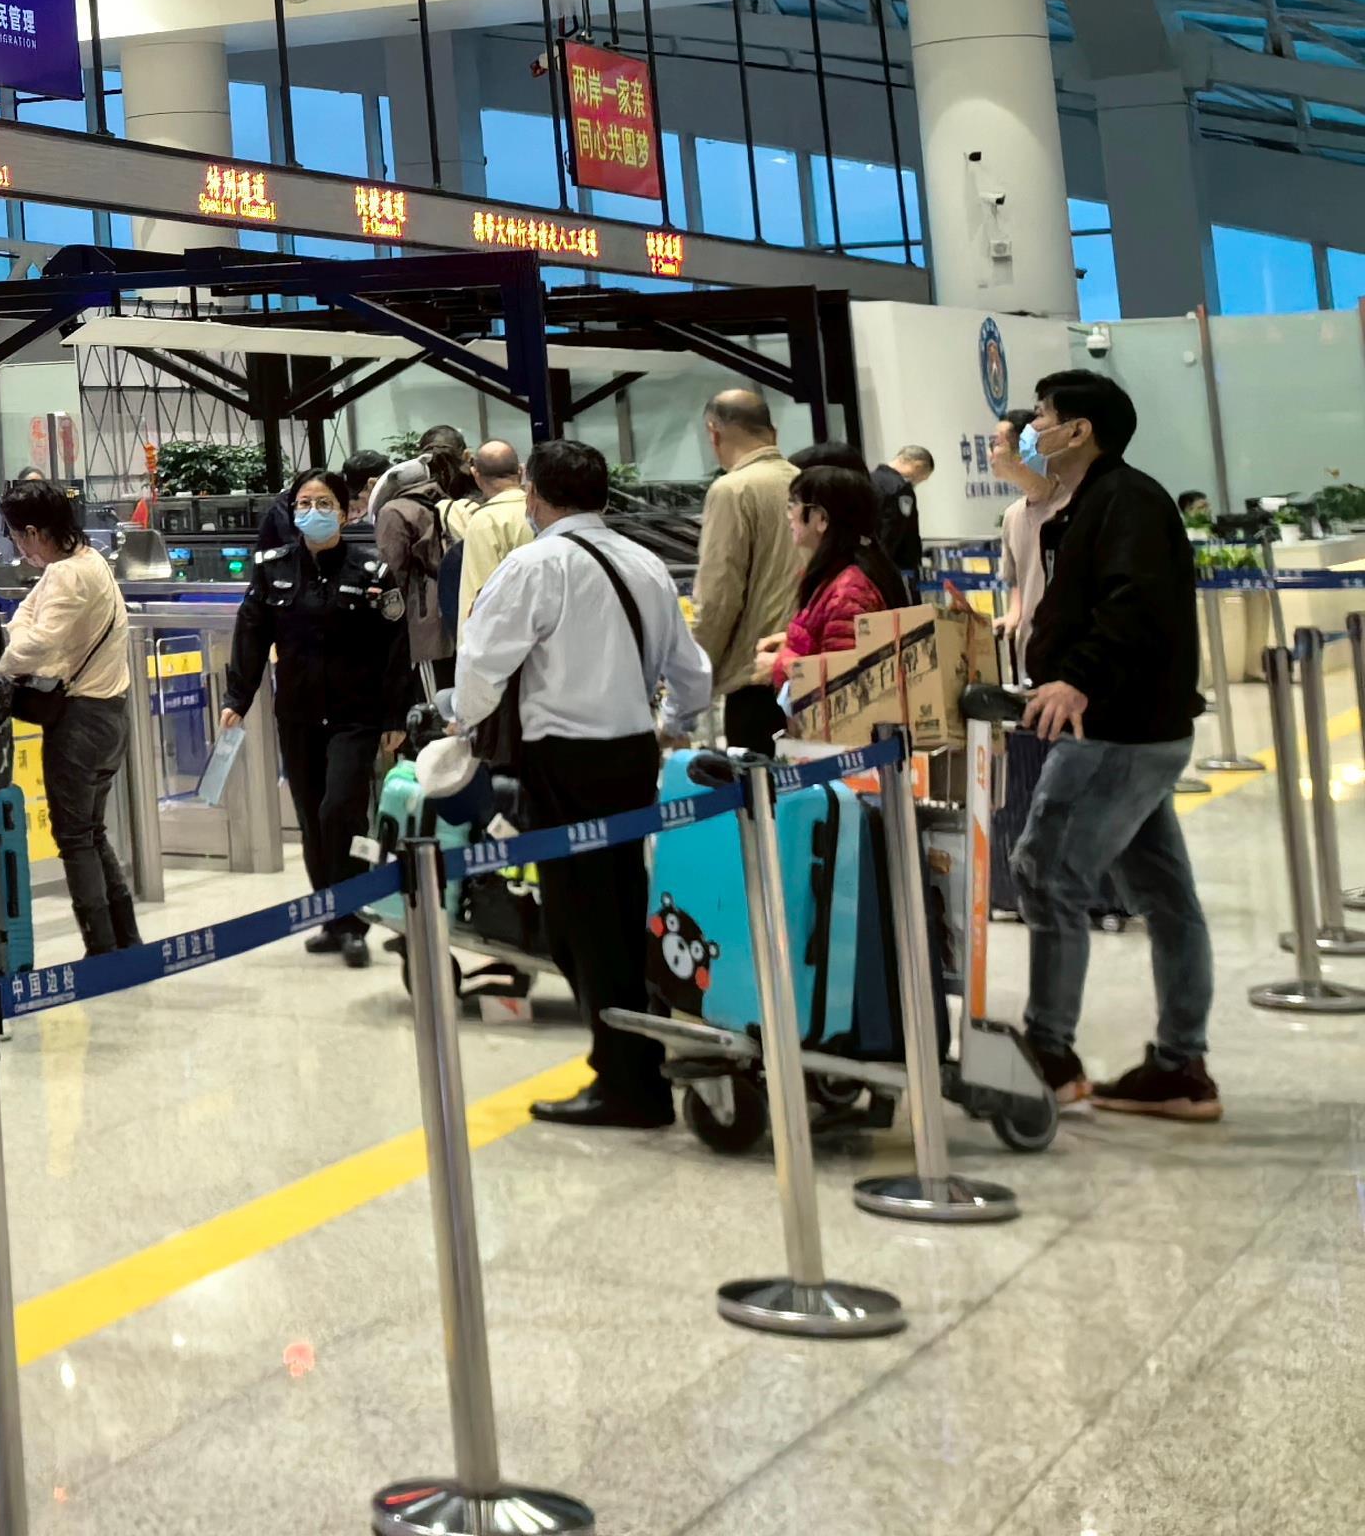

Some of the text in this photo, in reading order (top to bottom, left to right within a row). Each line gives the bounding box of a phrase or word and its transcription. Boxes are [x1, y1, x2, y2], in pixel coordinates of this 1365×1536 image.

[572, 64, 646, 119] 两岸一家亲
[577, 117, 650, 169] 同心共圆梦
[12, 963, 75, 1001] 中国边检
